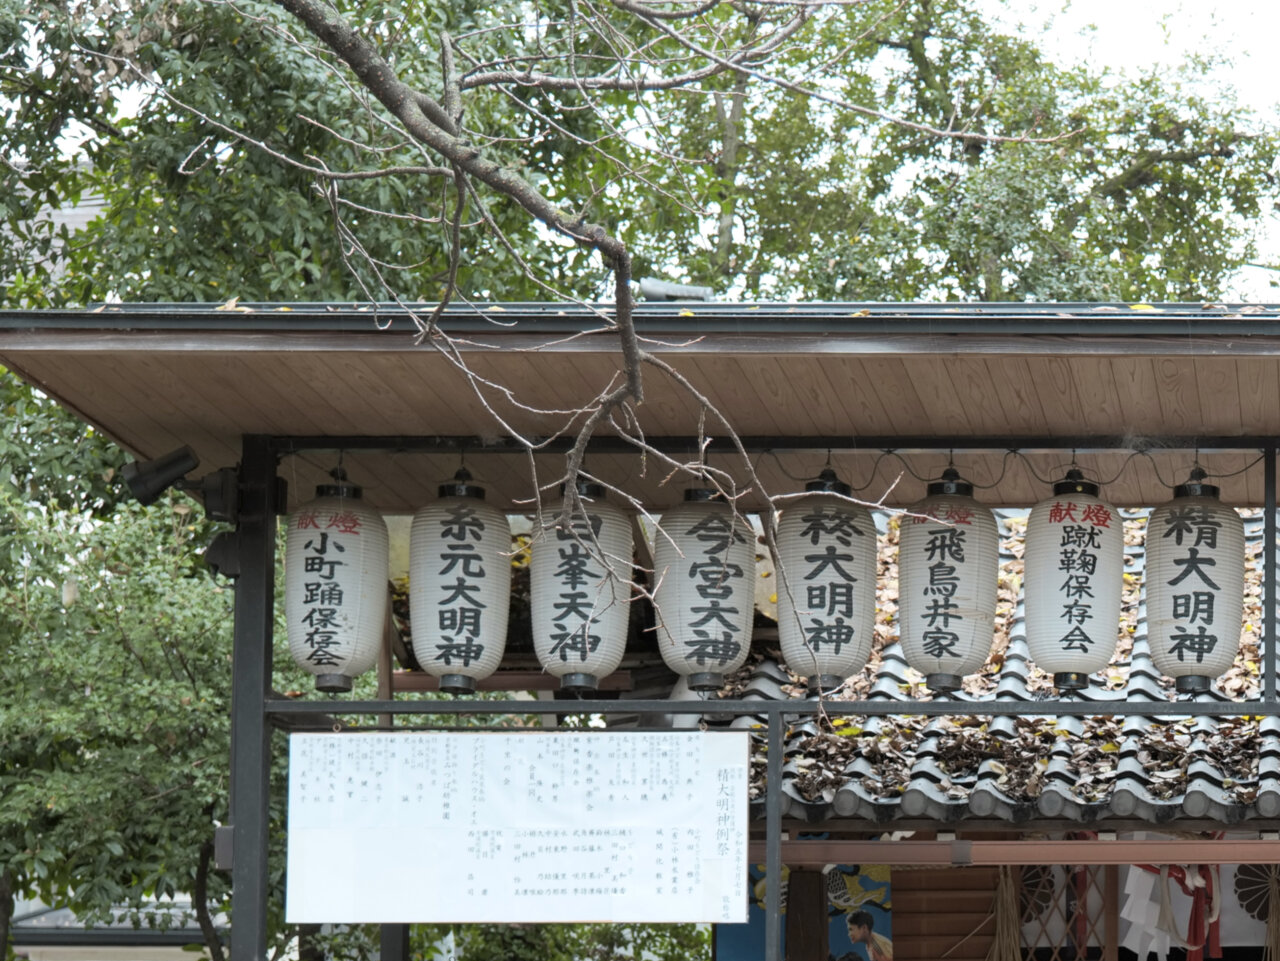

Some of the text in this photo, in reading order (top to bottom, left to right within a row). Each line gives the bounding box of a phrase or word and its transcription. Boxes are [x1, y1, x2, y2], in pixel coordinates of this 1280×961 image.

[302, 533, 345, 667] 小町踊保存会
[434, 506, 485, 667] 糸元大明神
[549, 512, 602, 662] 白峯天神
[683, 512, 746, 665] 今宮大神
[800, 507, 864, 655] 柊大明神
[922, 529, 965, 657] 飛鳥井家
[1059, 525, 1103, 653] 蹴鞠保存会
[1163, 507, 1223, 663] 精大明神
[716, 768, 729, 857] 精大明神例祭
